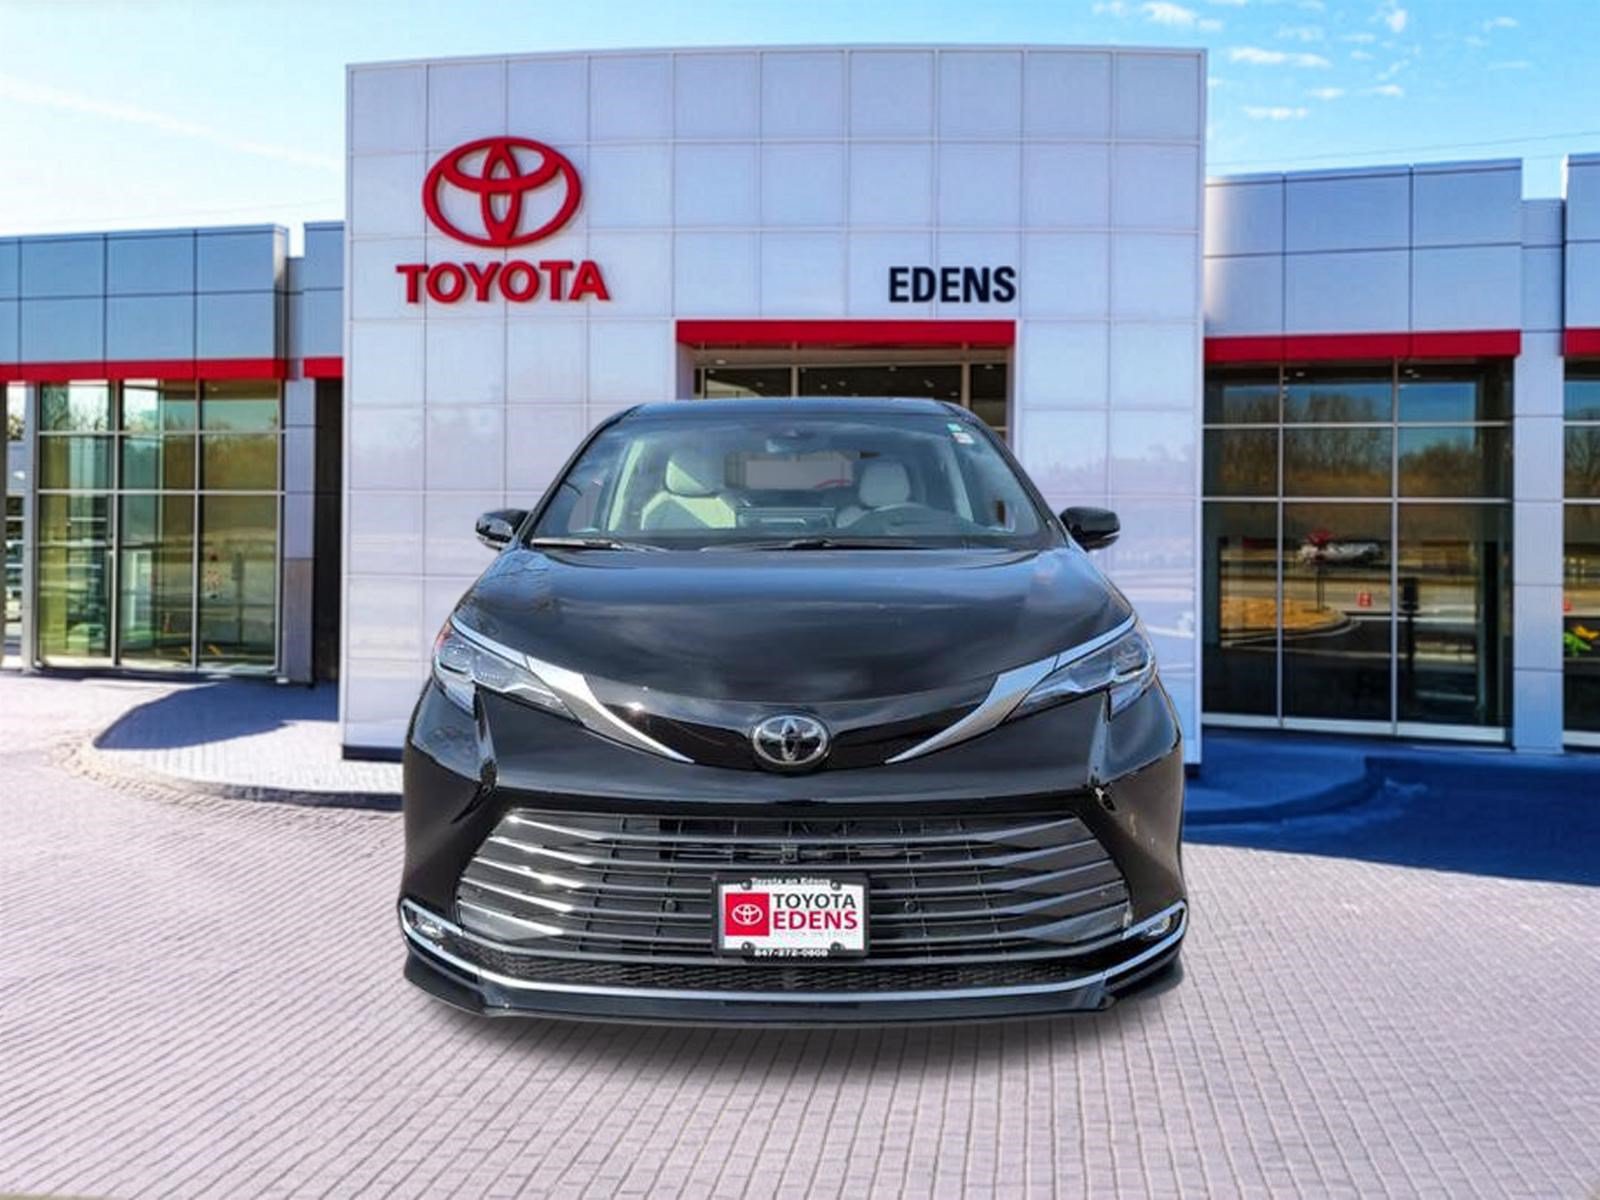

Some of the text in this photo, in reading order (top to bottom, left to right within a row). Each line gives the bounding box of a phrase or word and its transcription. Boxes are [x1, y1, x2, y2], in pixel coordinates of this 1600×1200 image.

[396, 259, 610, 304] TOYOTA
[889, 266, 1016, 303] EDENS
[773, 893, 857, 909] TOYOTA
[773, 911, 858, 930] EDENS
